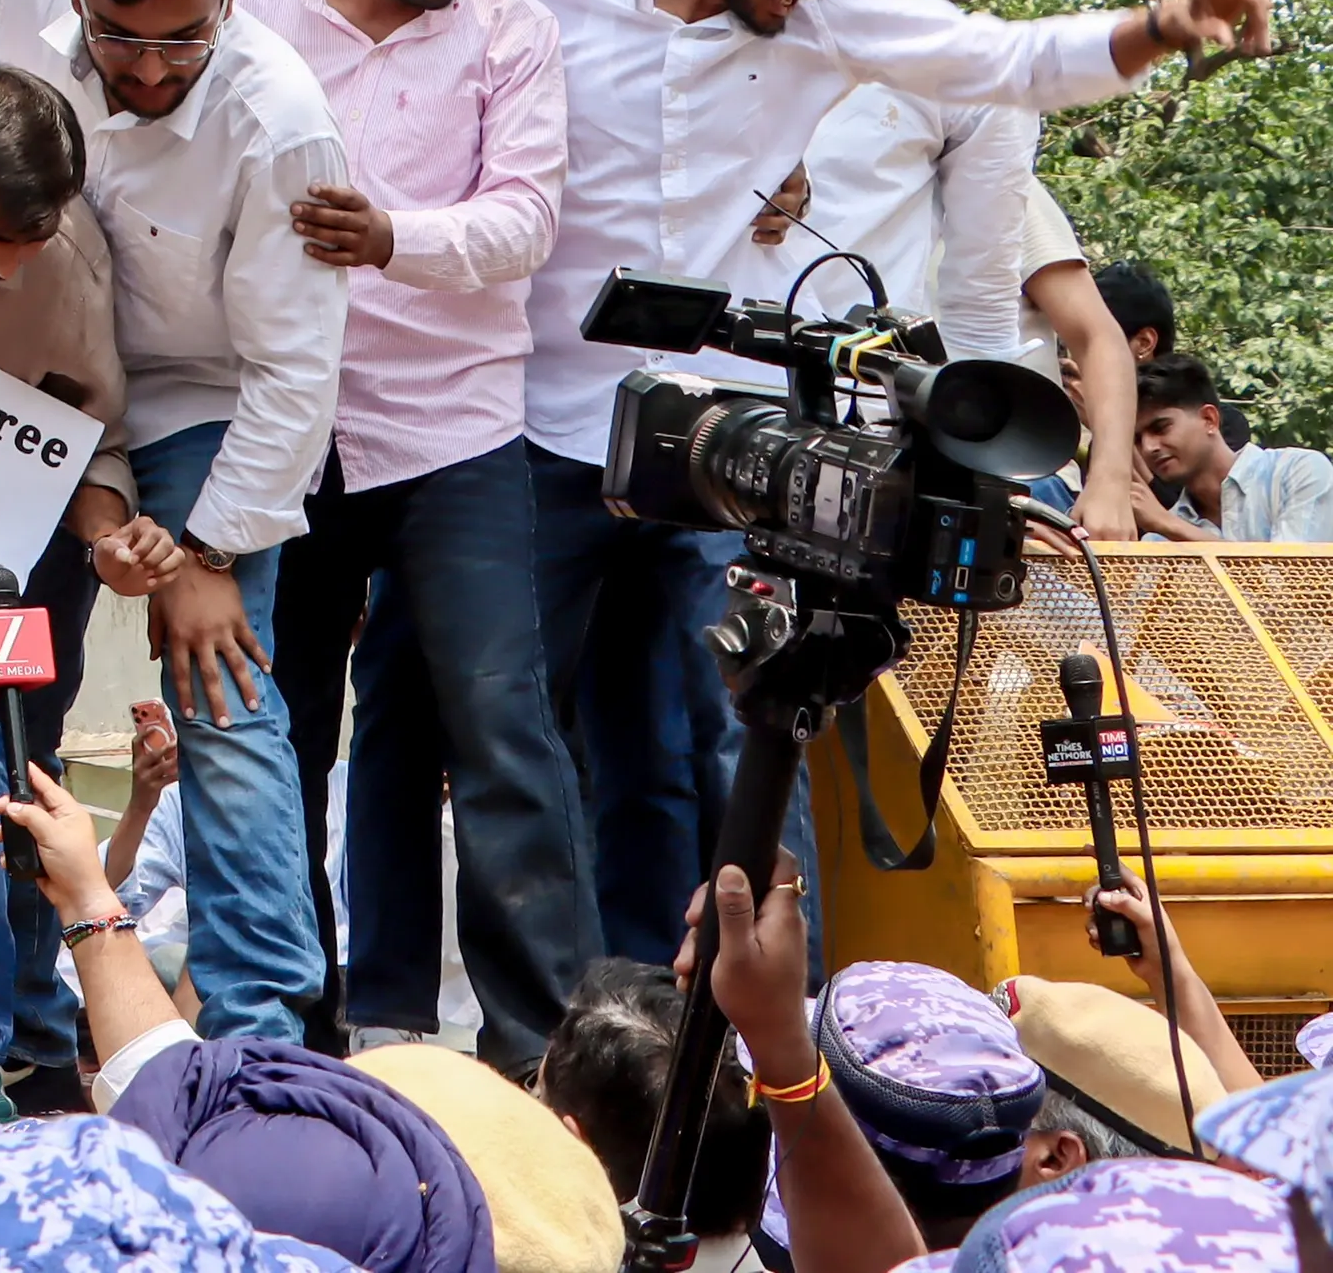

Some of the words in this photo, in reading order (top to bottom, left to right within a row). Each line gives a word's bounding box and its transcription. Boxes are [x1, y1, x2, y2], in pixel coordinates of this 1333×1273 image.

[7, 665, 44, 676] MEDIA
[1055, 741, 1083, 753] TIMES
[1047, 750, 1093, 762] NETWORK
